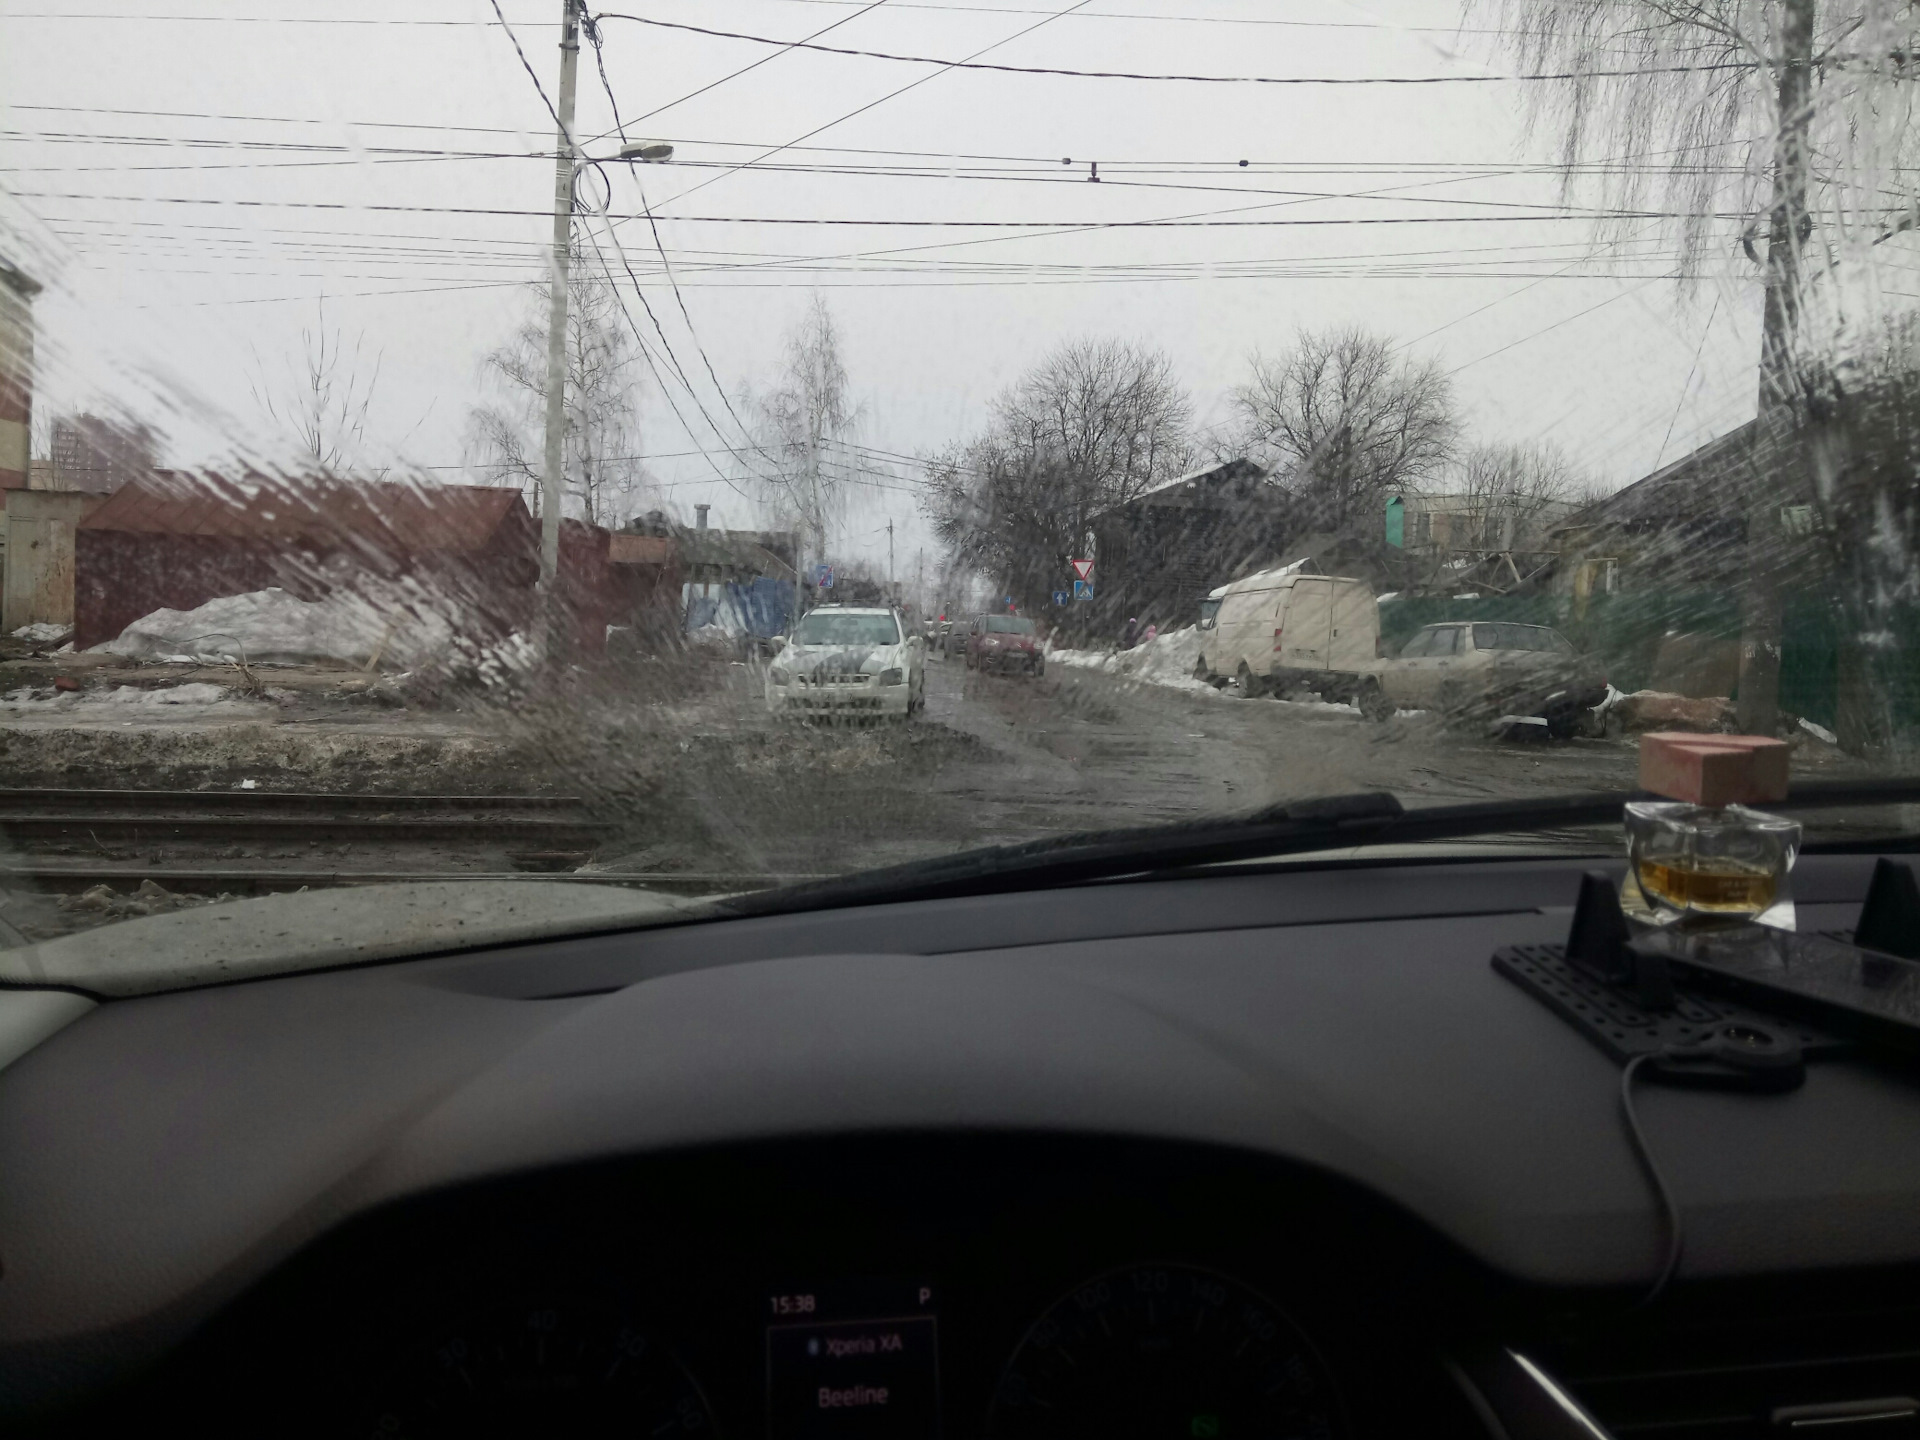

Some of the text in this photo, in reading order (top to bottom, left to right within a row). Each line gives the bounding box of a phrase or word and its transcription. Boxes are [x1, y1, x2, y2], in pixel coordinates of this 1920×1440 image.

[769, 1294, 816, 1314] 15:38
[918, 1286, 932, 1305] P
[825, 1333, 903, 1359] Xperia XA
[818, 1385, 889, 1409] Beeline
